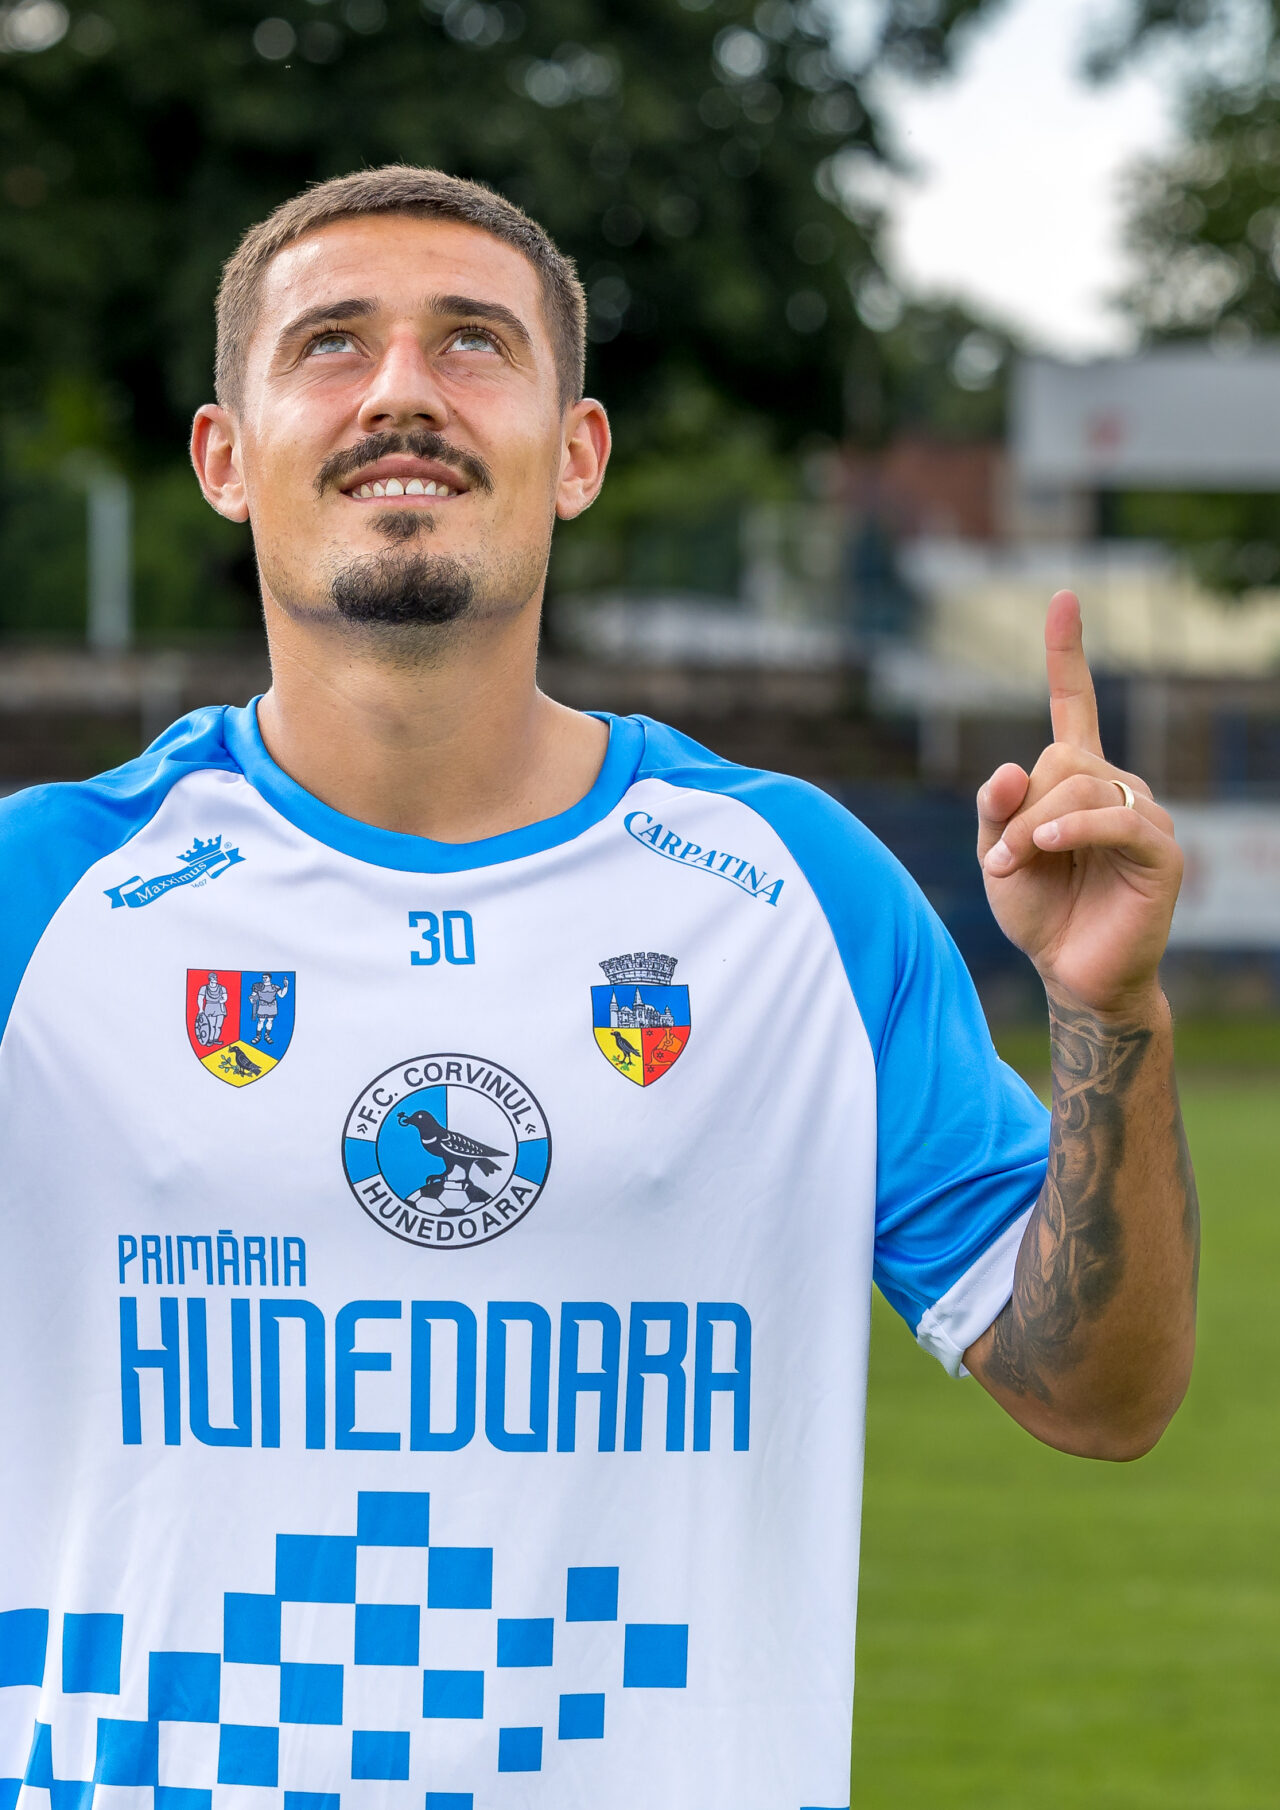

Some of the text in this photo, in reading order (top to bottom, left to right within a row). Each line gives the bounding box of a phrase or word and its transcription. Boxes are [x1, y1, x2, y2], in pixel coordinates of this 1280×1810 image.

[135, 861, 207, 904] Maxximus
[623, 810, 785, 907] CARPATINA
[408, 910, 475, 966] 30
[358, 1061, 532, 1125] F.C. CORVINUL
[362, 1181, 533, 1241] HUNEDOARA
[119, 1296, 752, 1453] HUNEDOARA
